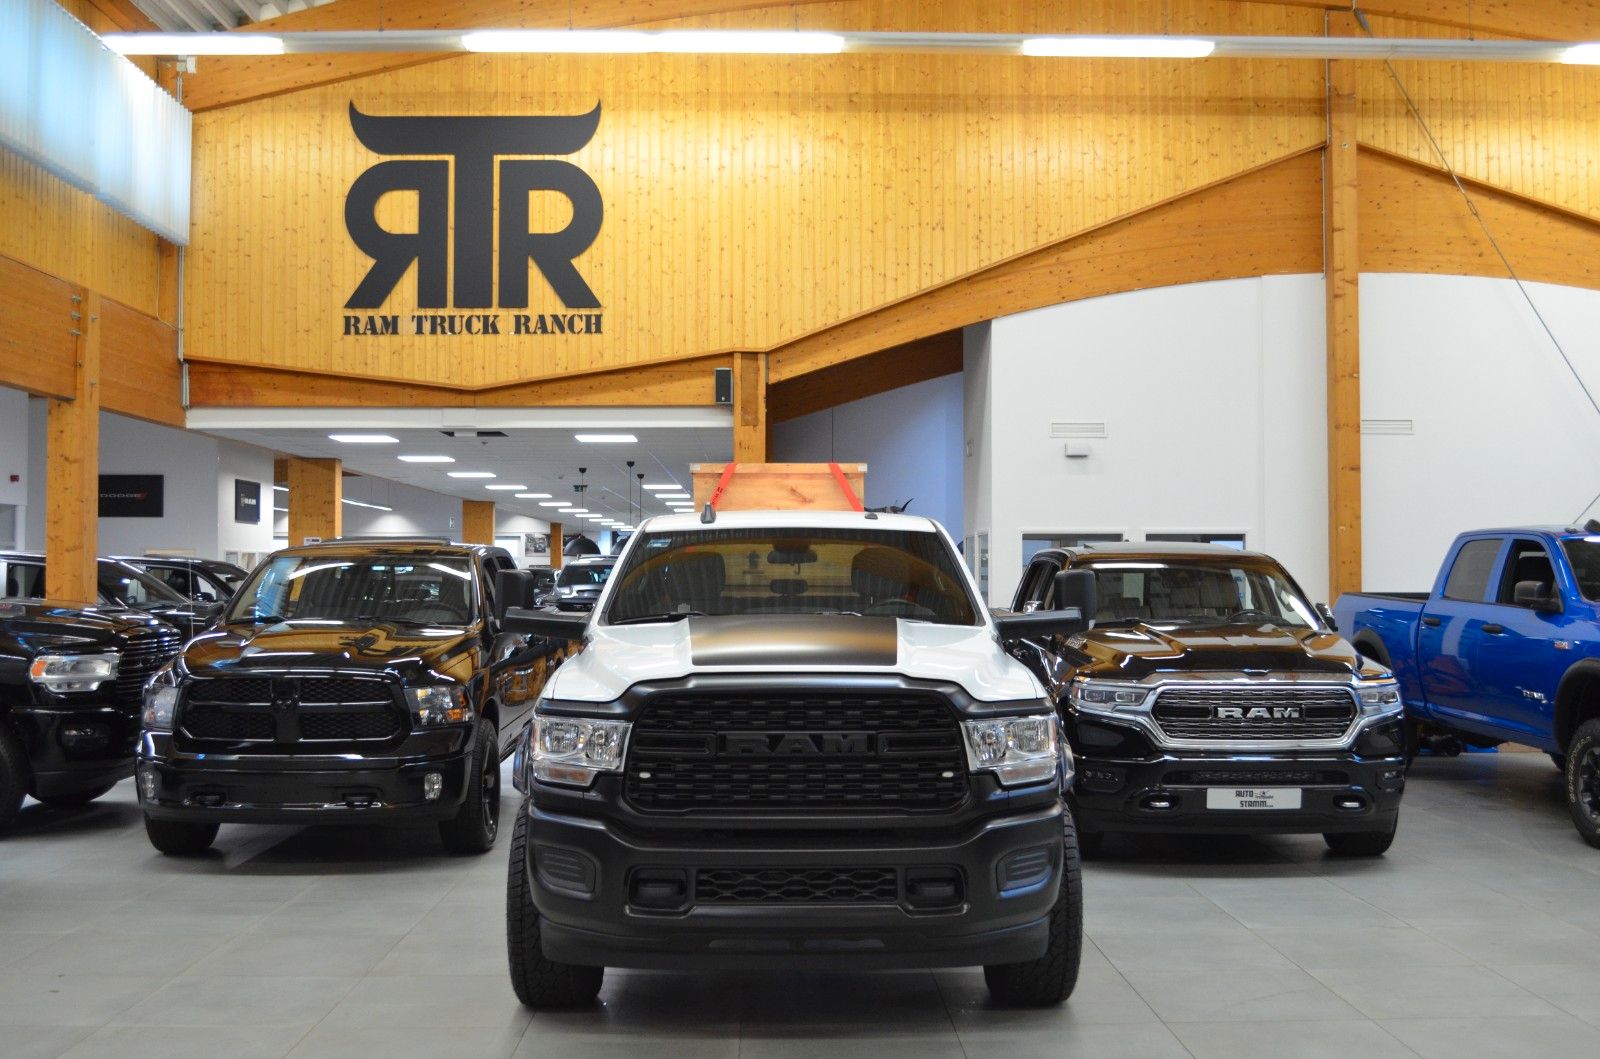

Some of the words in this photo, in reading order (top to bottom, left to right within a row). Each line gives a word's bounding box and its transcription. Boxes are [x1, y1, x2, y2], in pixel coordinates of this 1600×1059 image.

[343, 315, 400, 336] RAM
[411, 315, 500, 335] TRUCK
[513, 314, 603, 335] RANCH
[1217, 707, 1300, 719] RAM
[725, 733, 867, 755] RAM
[1240, 800, 1267, 808] STAMM
